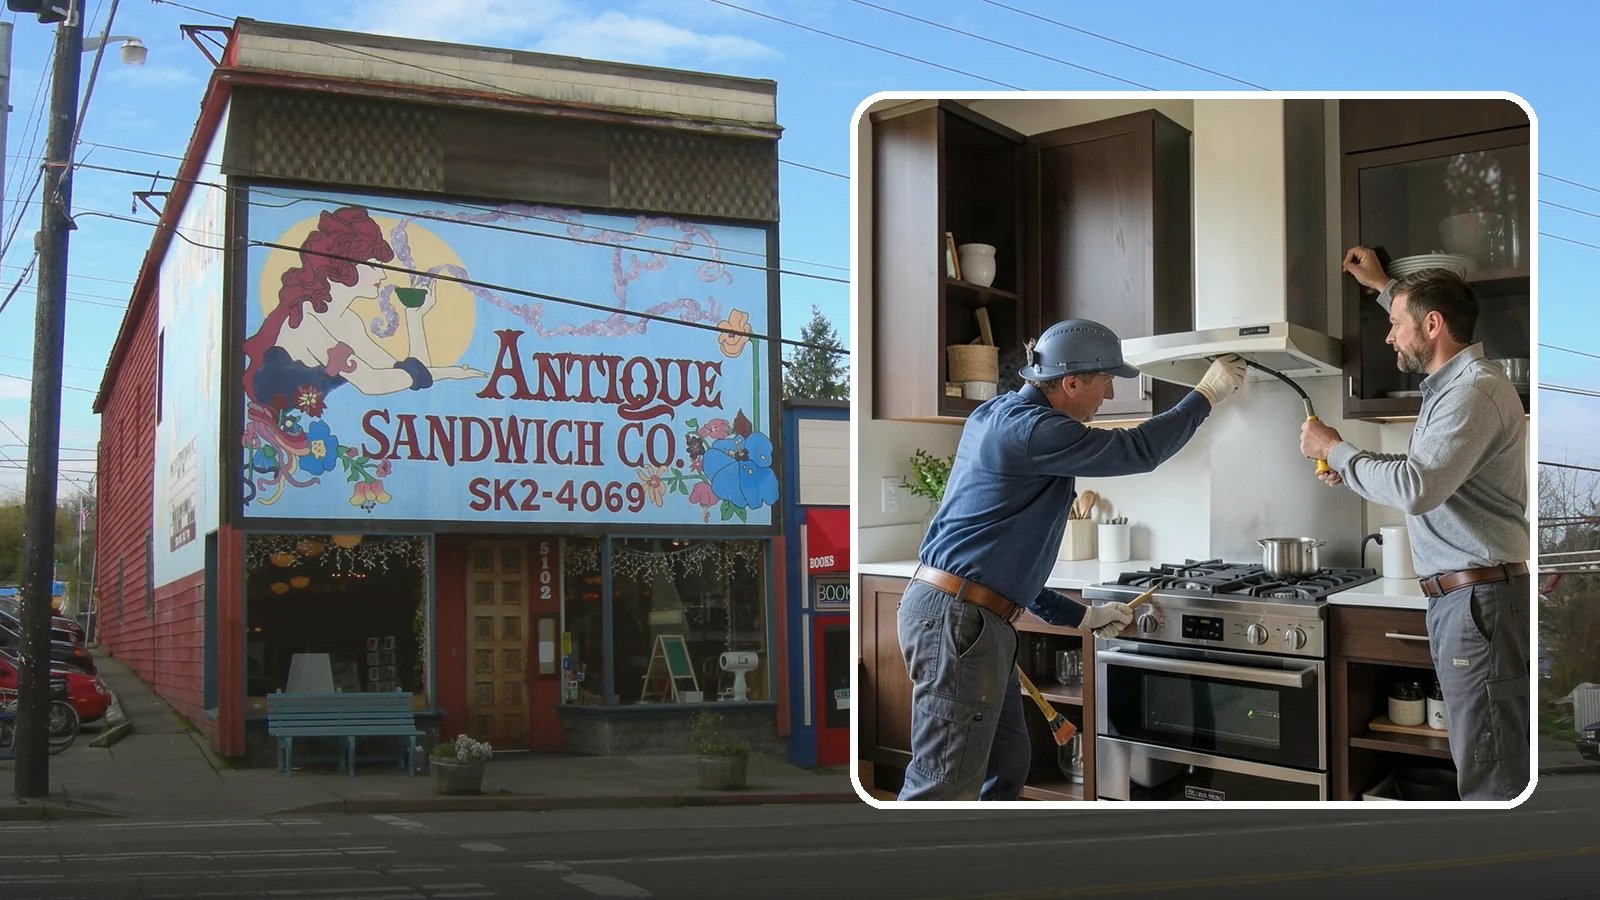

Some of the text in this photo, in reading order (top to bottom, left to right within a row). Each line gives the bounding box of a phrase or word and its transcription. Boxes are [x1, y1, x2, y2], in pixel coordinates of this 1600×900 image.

[475, 329, 724, 421] ANTIQUE
[361, 408, 685, 468] SANDWICH CO.
[468, 476, 646, 513] SK2-4069
[539, 541, 552, 600] 5102
[809, 555, 835, 569] BOOKS
